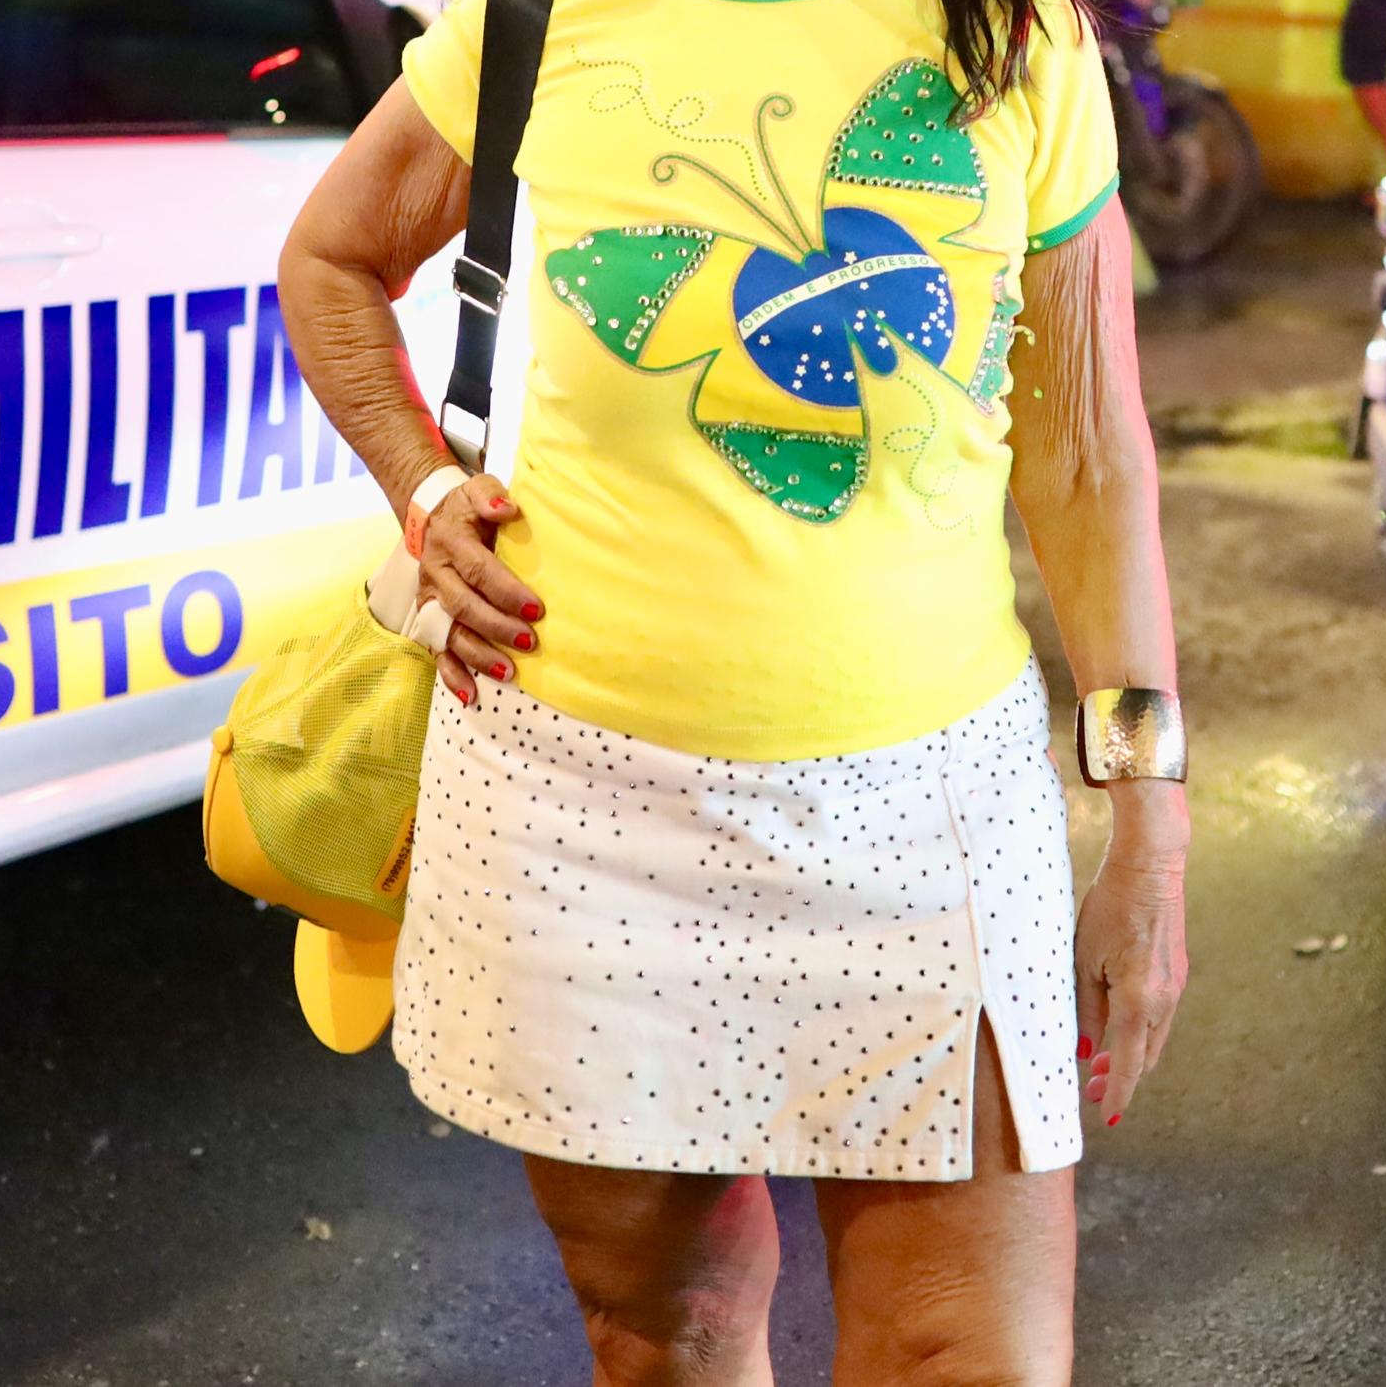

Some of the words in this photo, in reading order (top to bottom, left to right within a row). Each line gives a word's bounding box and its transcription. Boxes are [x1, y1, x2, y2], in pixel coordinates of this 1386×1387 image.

[742, 292, 796, 330] ORDEM
[806, 283, 817, 294] E
[827, 256, 930, 285] PROGRESSO
